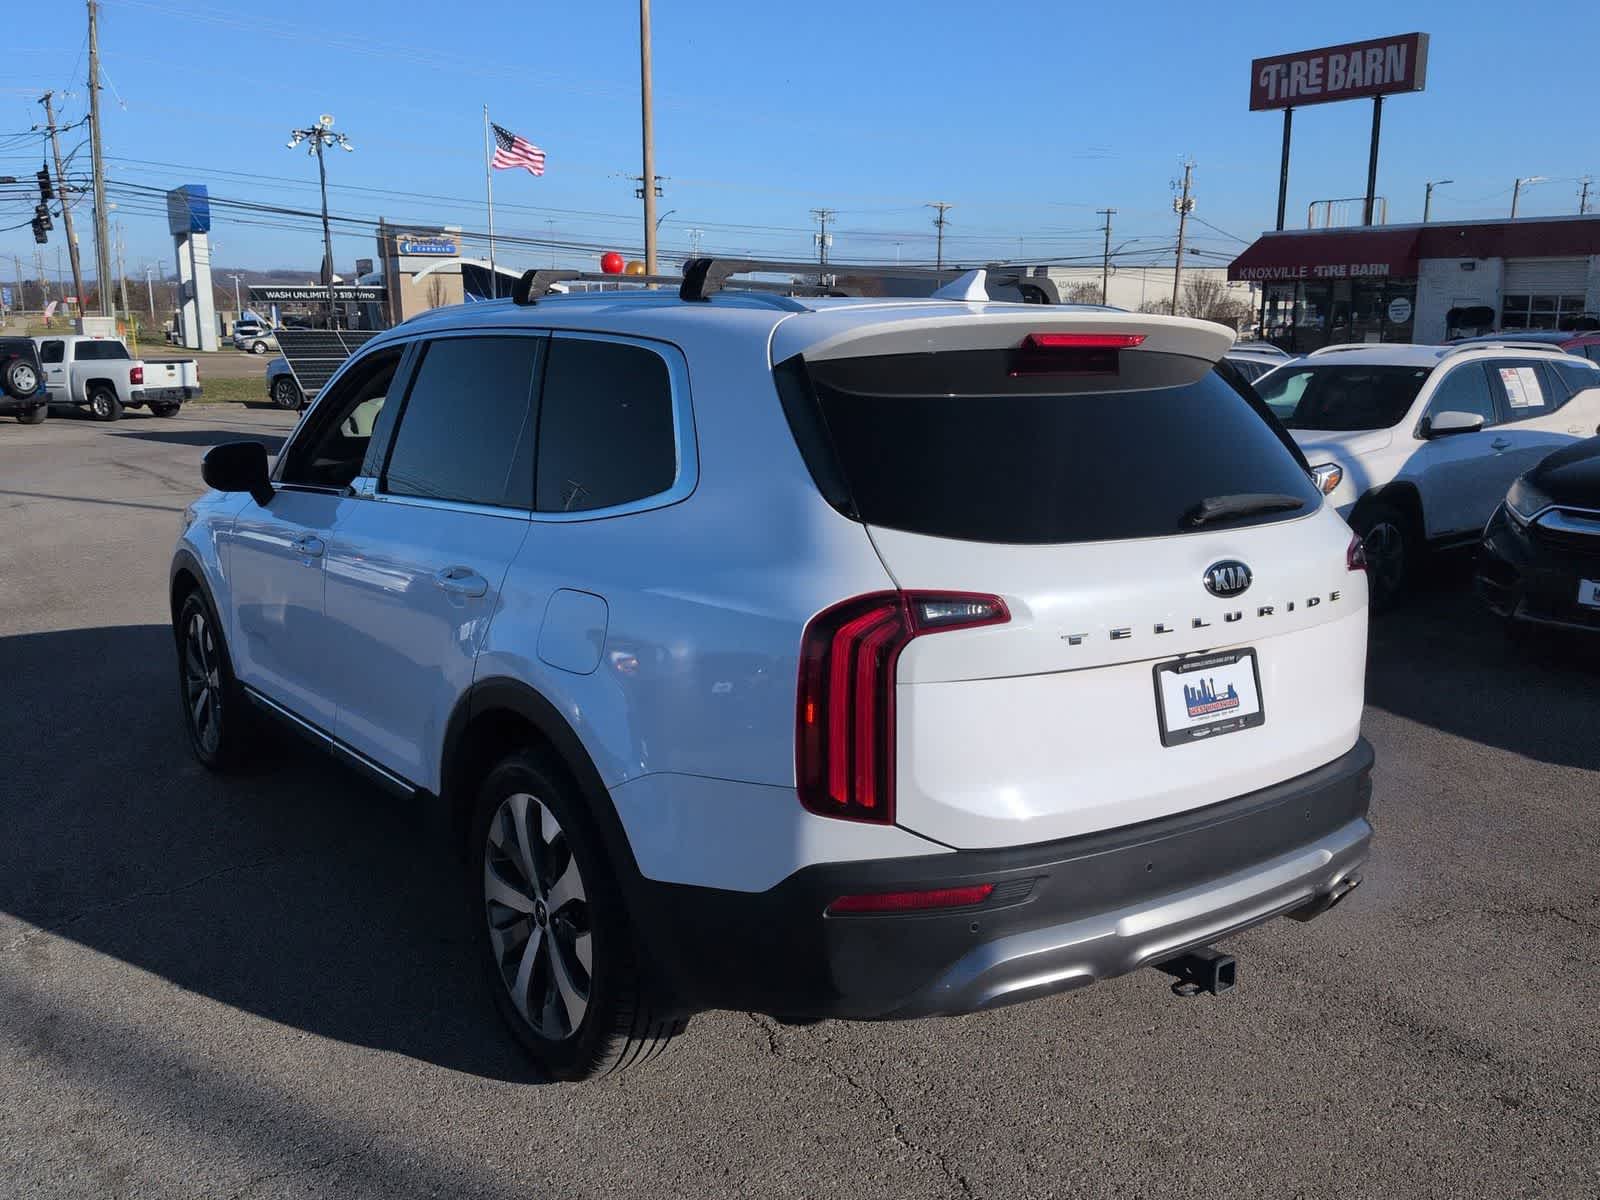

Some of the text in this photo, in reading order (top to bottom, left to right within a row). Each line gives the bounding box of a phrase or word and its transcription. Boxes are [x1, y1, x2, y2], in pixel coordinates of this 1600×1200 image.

[1327, 43, 1408, 92] BARN
[1239, 265, 1308, 280] KNOXVILLE
[1350, 263, 1390, 277] BARN
[265, 291, 292, 299] WASH
[1212, 565, 1249, 591] KIA
[1060, 590, 1341, 646] TELLURIDE
